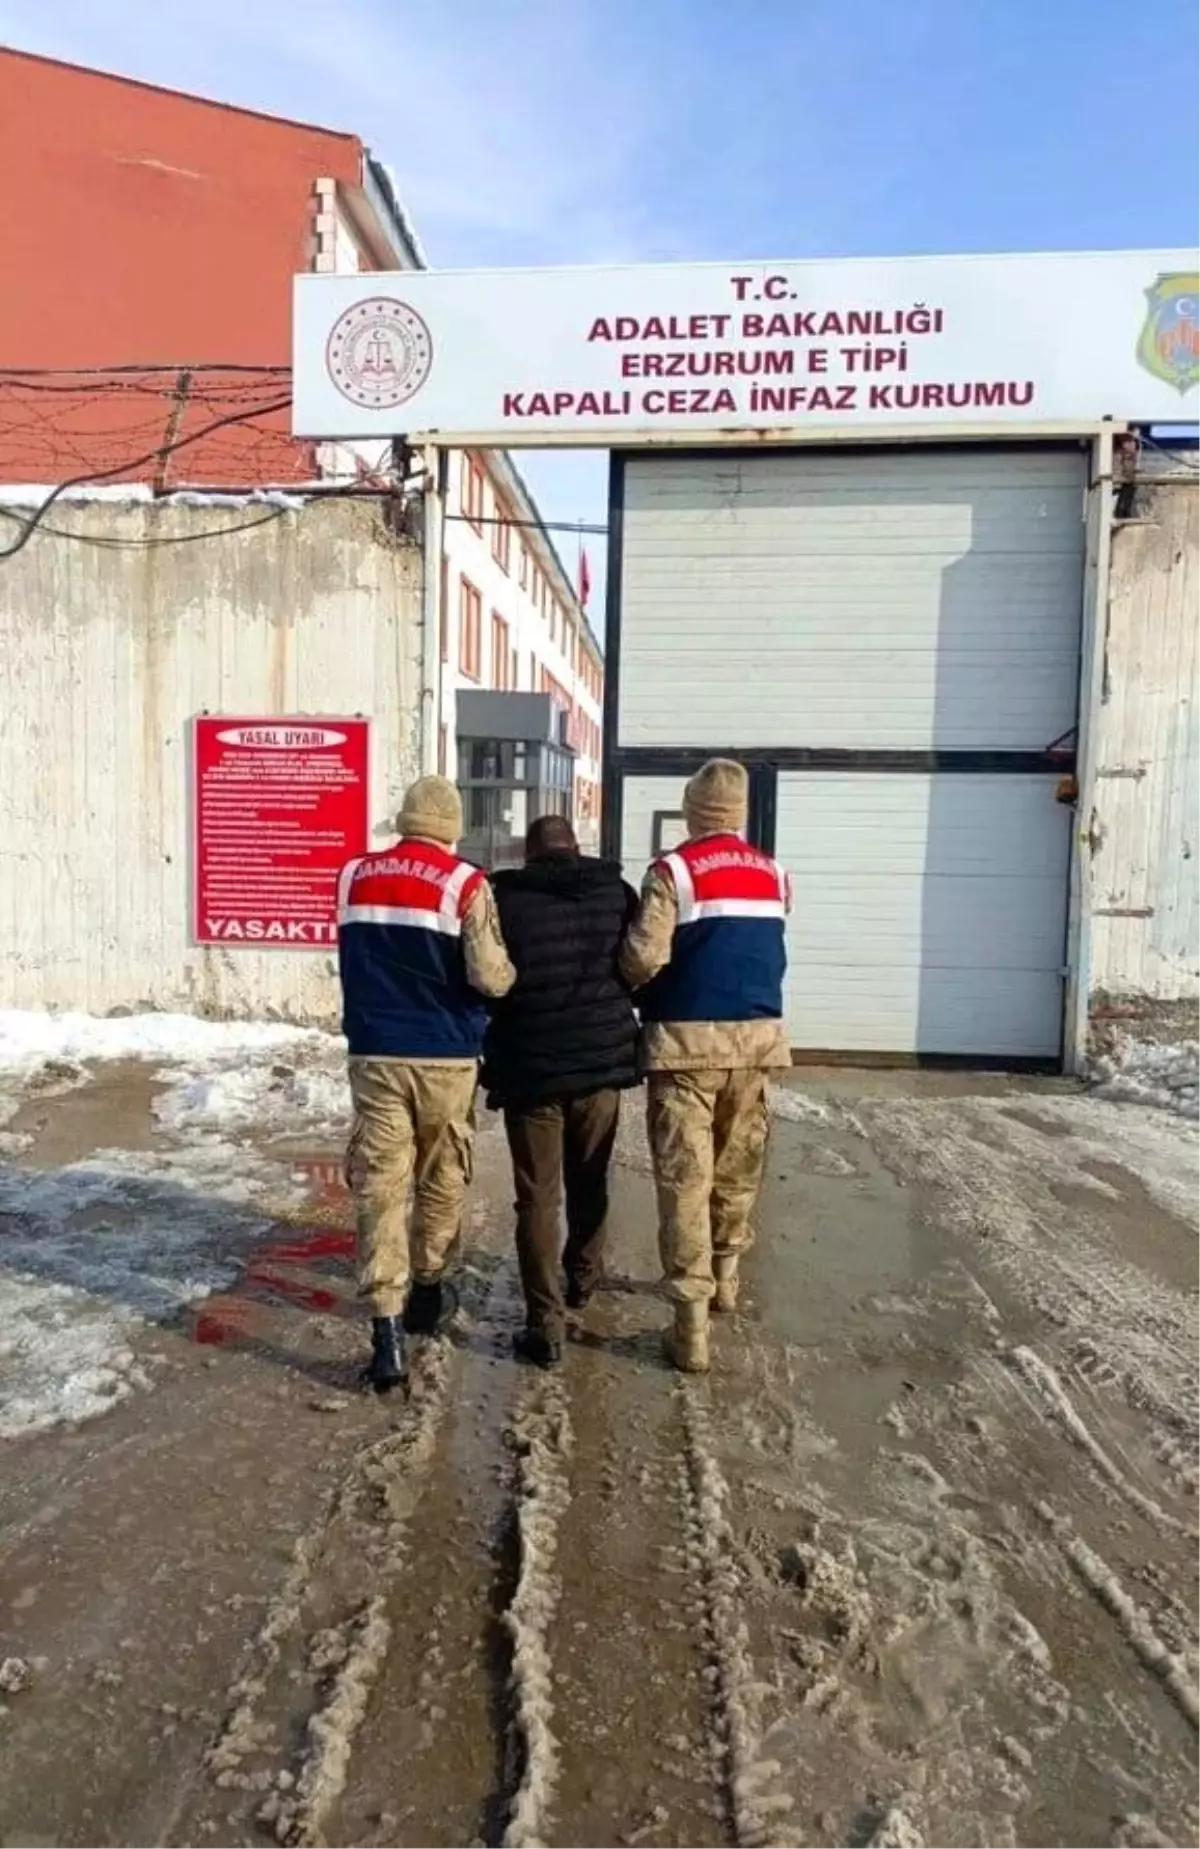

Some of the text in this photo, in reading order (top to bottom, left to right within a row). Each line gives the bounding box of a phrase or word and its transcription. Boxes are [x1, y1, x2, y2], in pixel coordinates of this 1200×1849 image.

[730, 275, 798, 301] T.C.
[587, 302, 944, 342] ADALET BAKANLIĞI
[621, 341, 907, 378] ERZURUM E TİPİ
[503, 381, 1034, 417] KAPALI CEZA İNFAZ KURUMU
[238, 731, 325, 746] YASAL UYARI
[205, 919, 338, 941] YASAKTI
